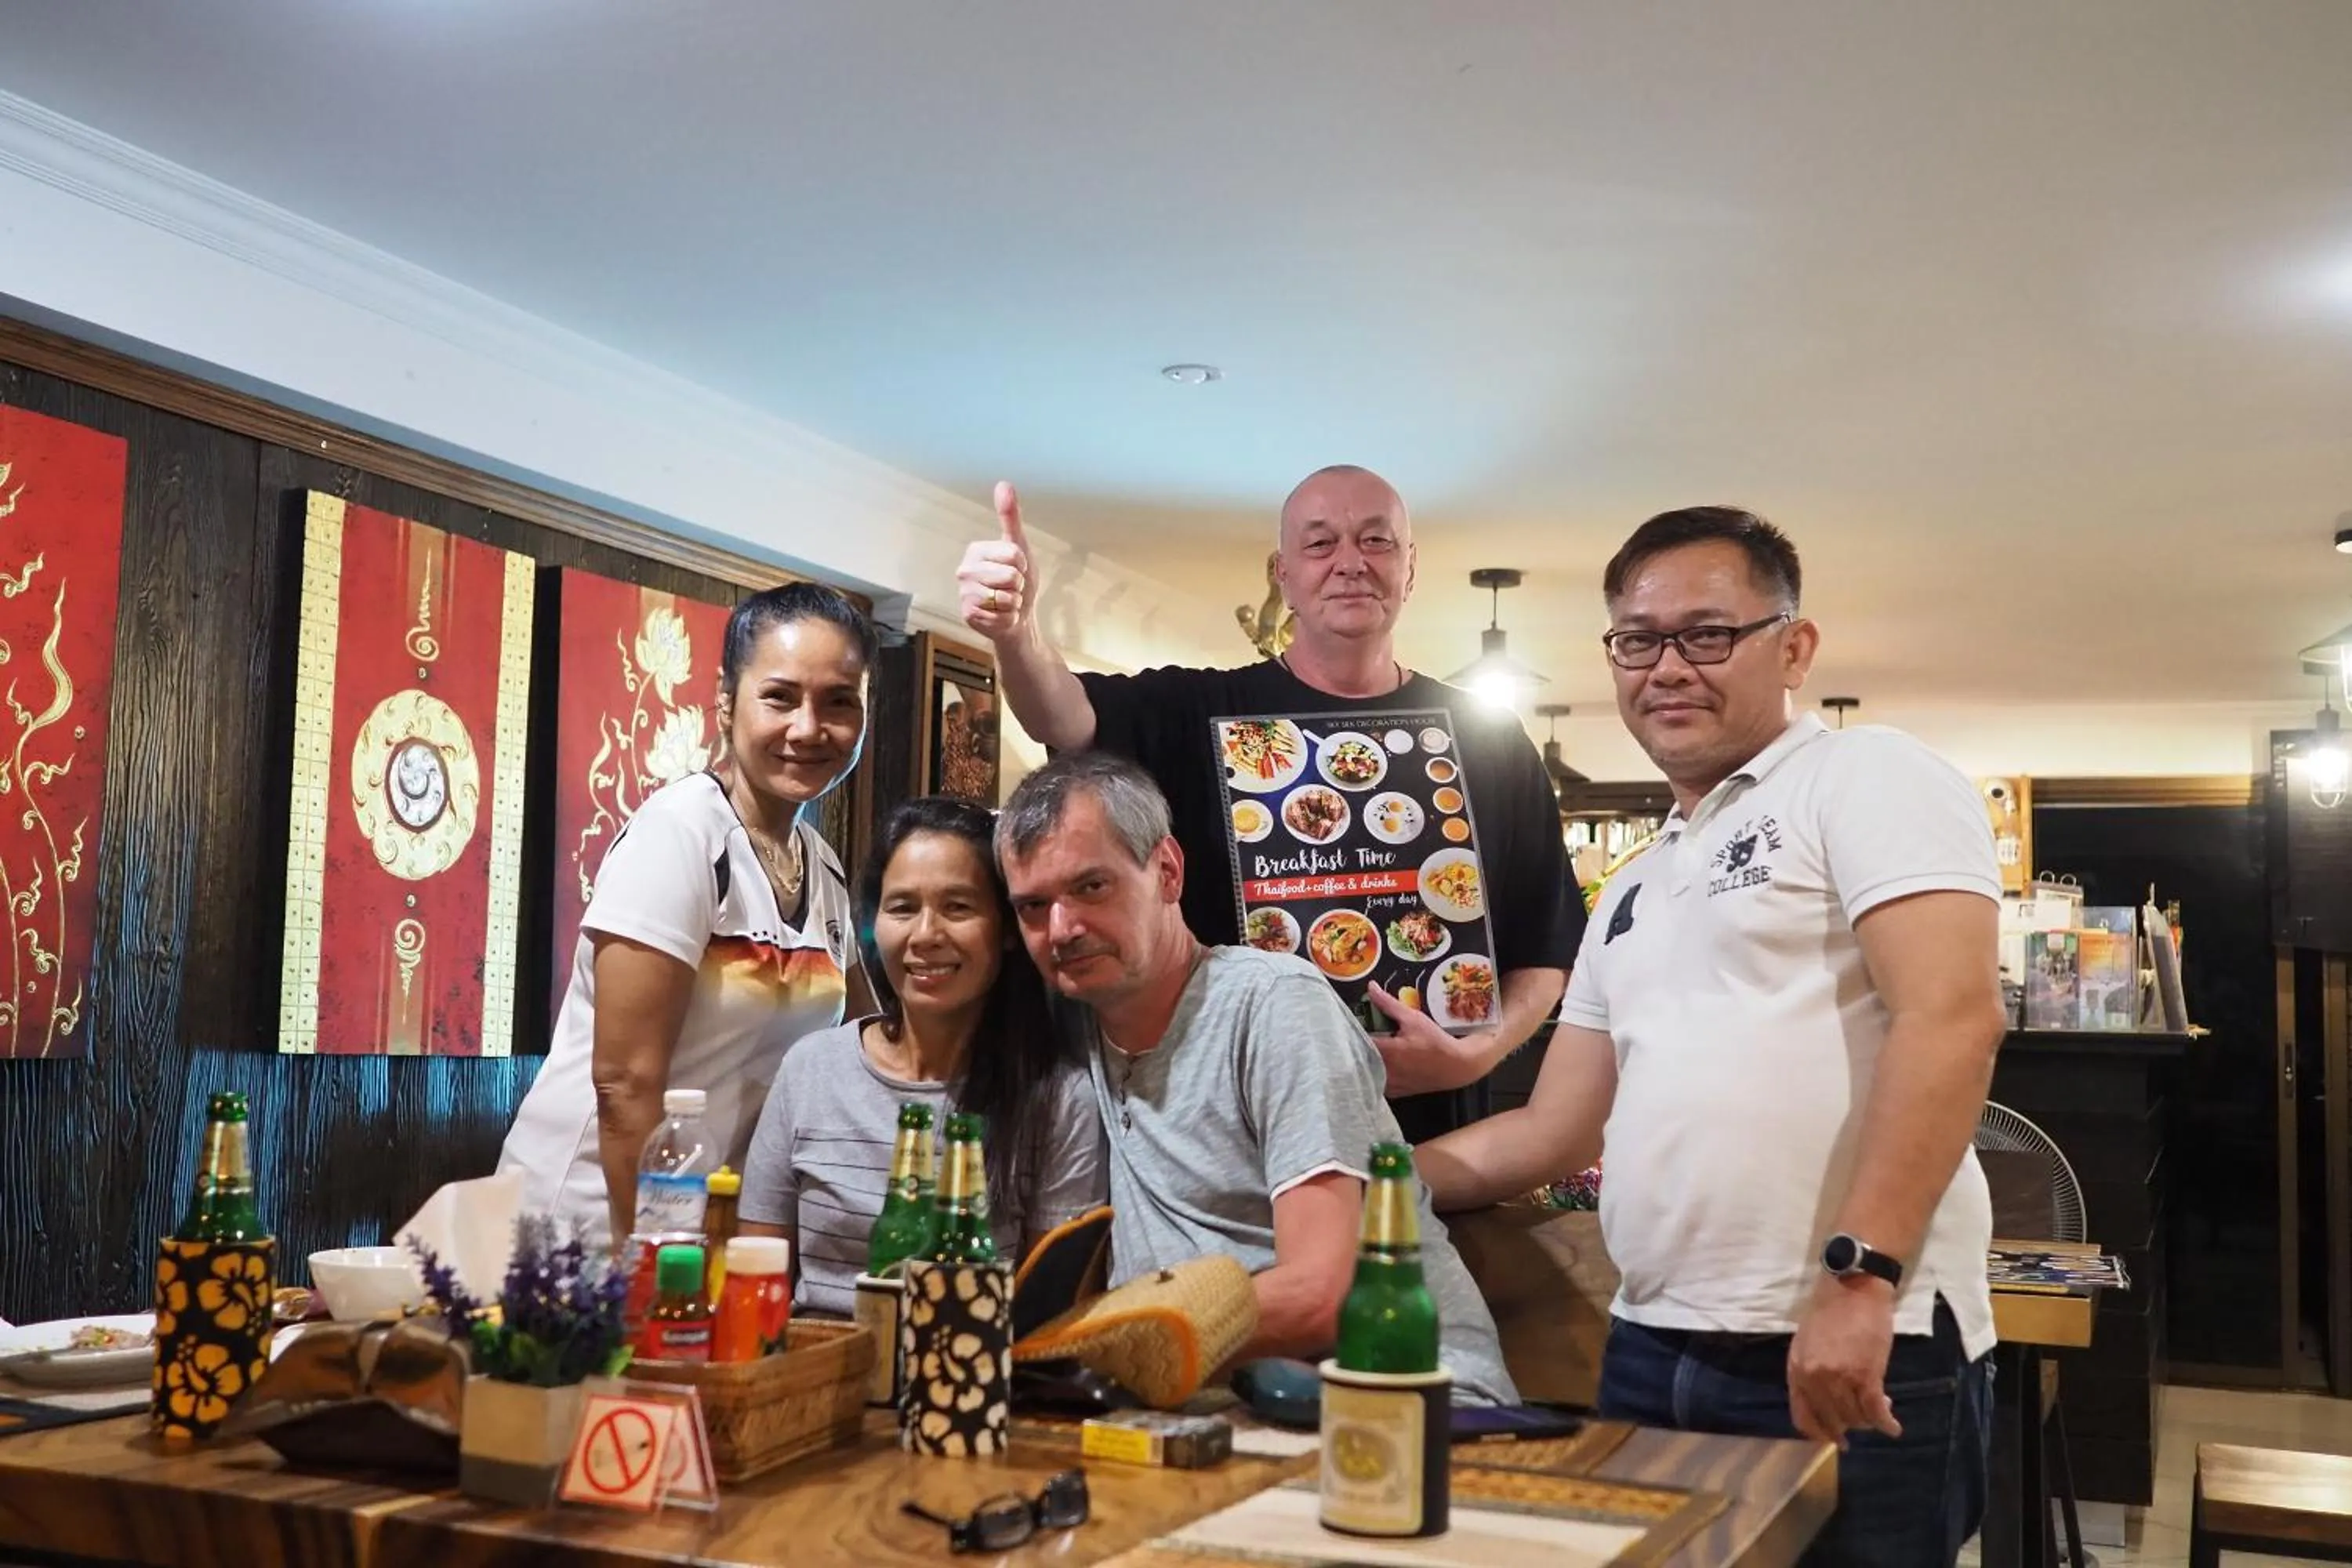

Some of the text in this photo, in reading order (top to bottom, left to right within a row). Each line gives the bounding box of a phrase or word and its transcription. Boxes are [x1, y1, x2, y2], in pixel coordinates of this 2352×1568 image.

[1254, 848, 1396, 877] Breakfast Time
[1360, 874, 1398, 888] drinks
[1708, 865, 1773, 897] COLLEGE
[1398, 893, 1417, 907] day
